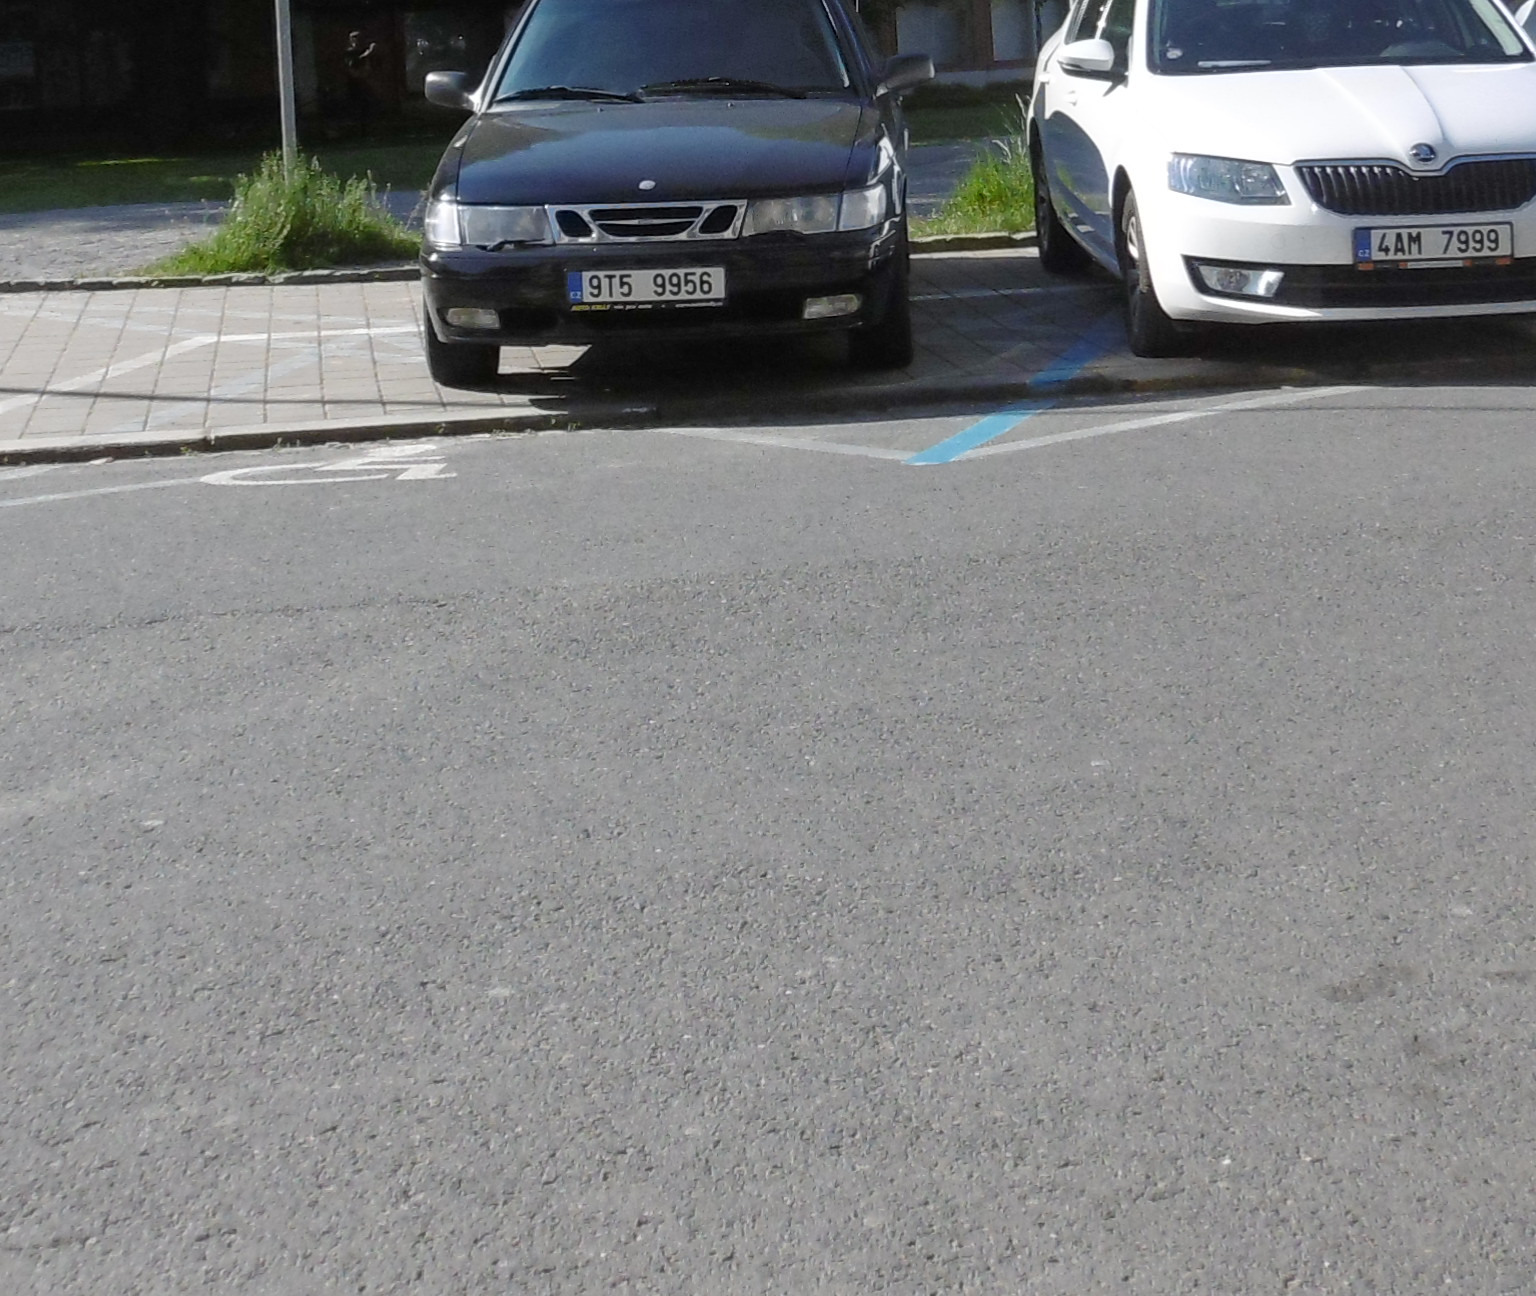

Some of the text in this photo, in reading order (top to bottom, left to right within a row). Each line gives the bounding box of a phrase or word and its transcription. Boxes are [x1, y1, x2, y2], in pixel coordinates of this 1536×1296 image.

[1358, 228, 1500, 257] CZ 4AM 7999
[588, 273, 633, 299] 9T5
[652, 271, 713, 297] 9956
